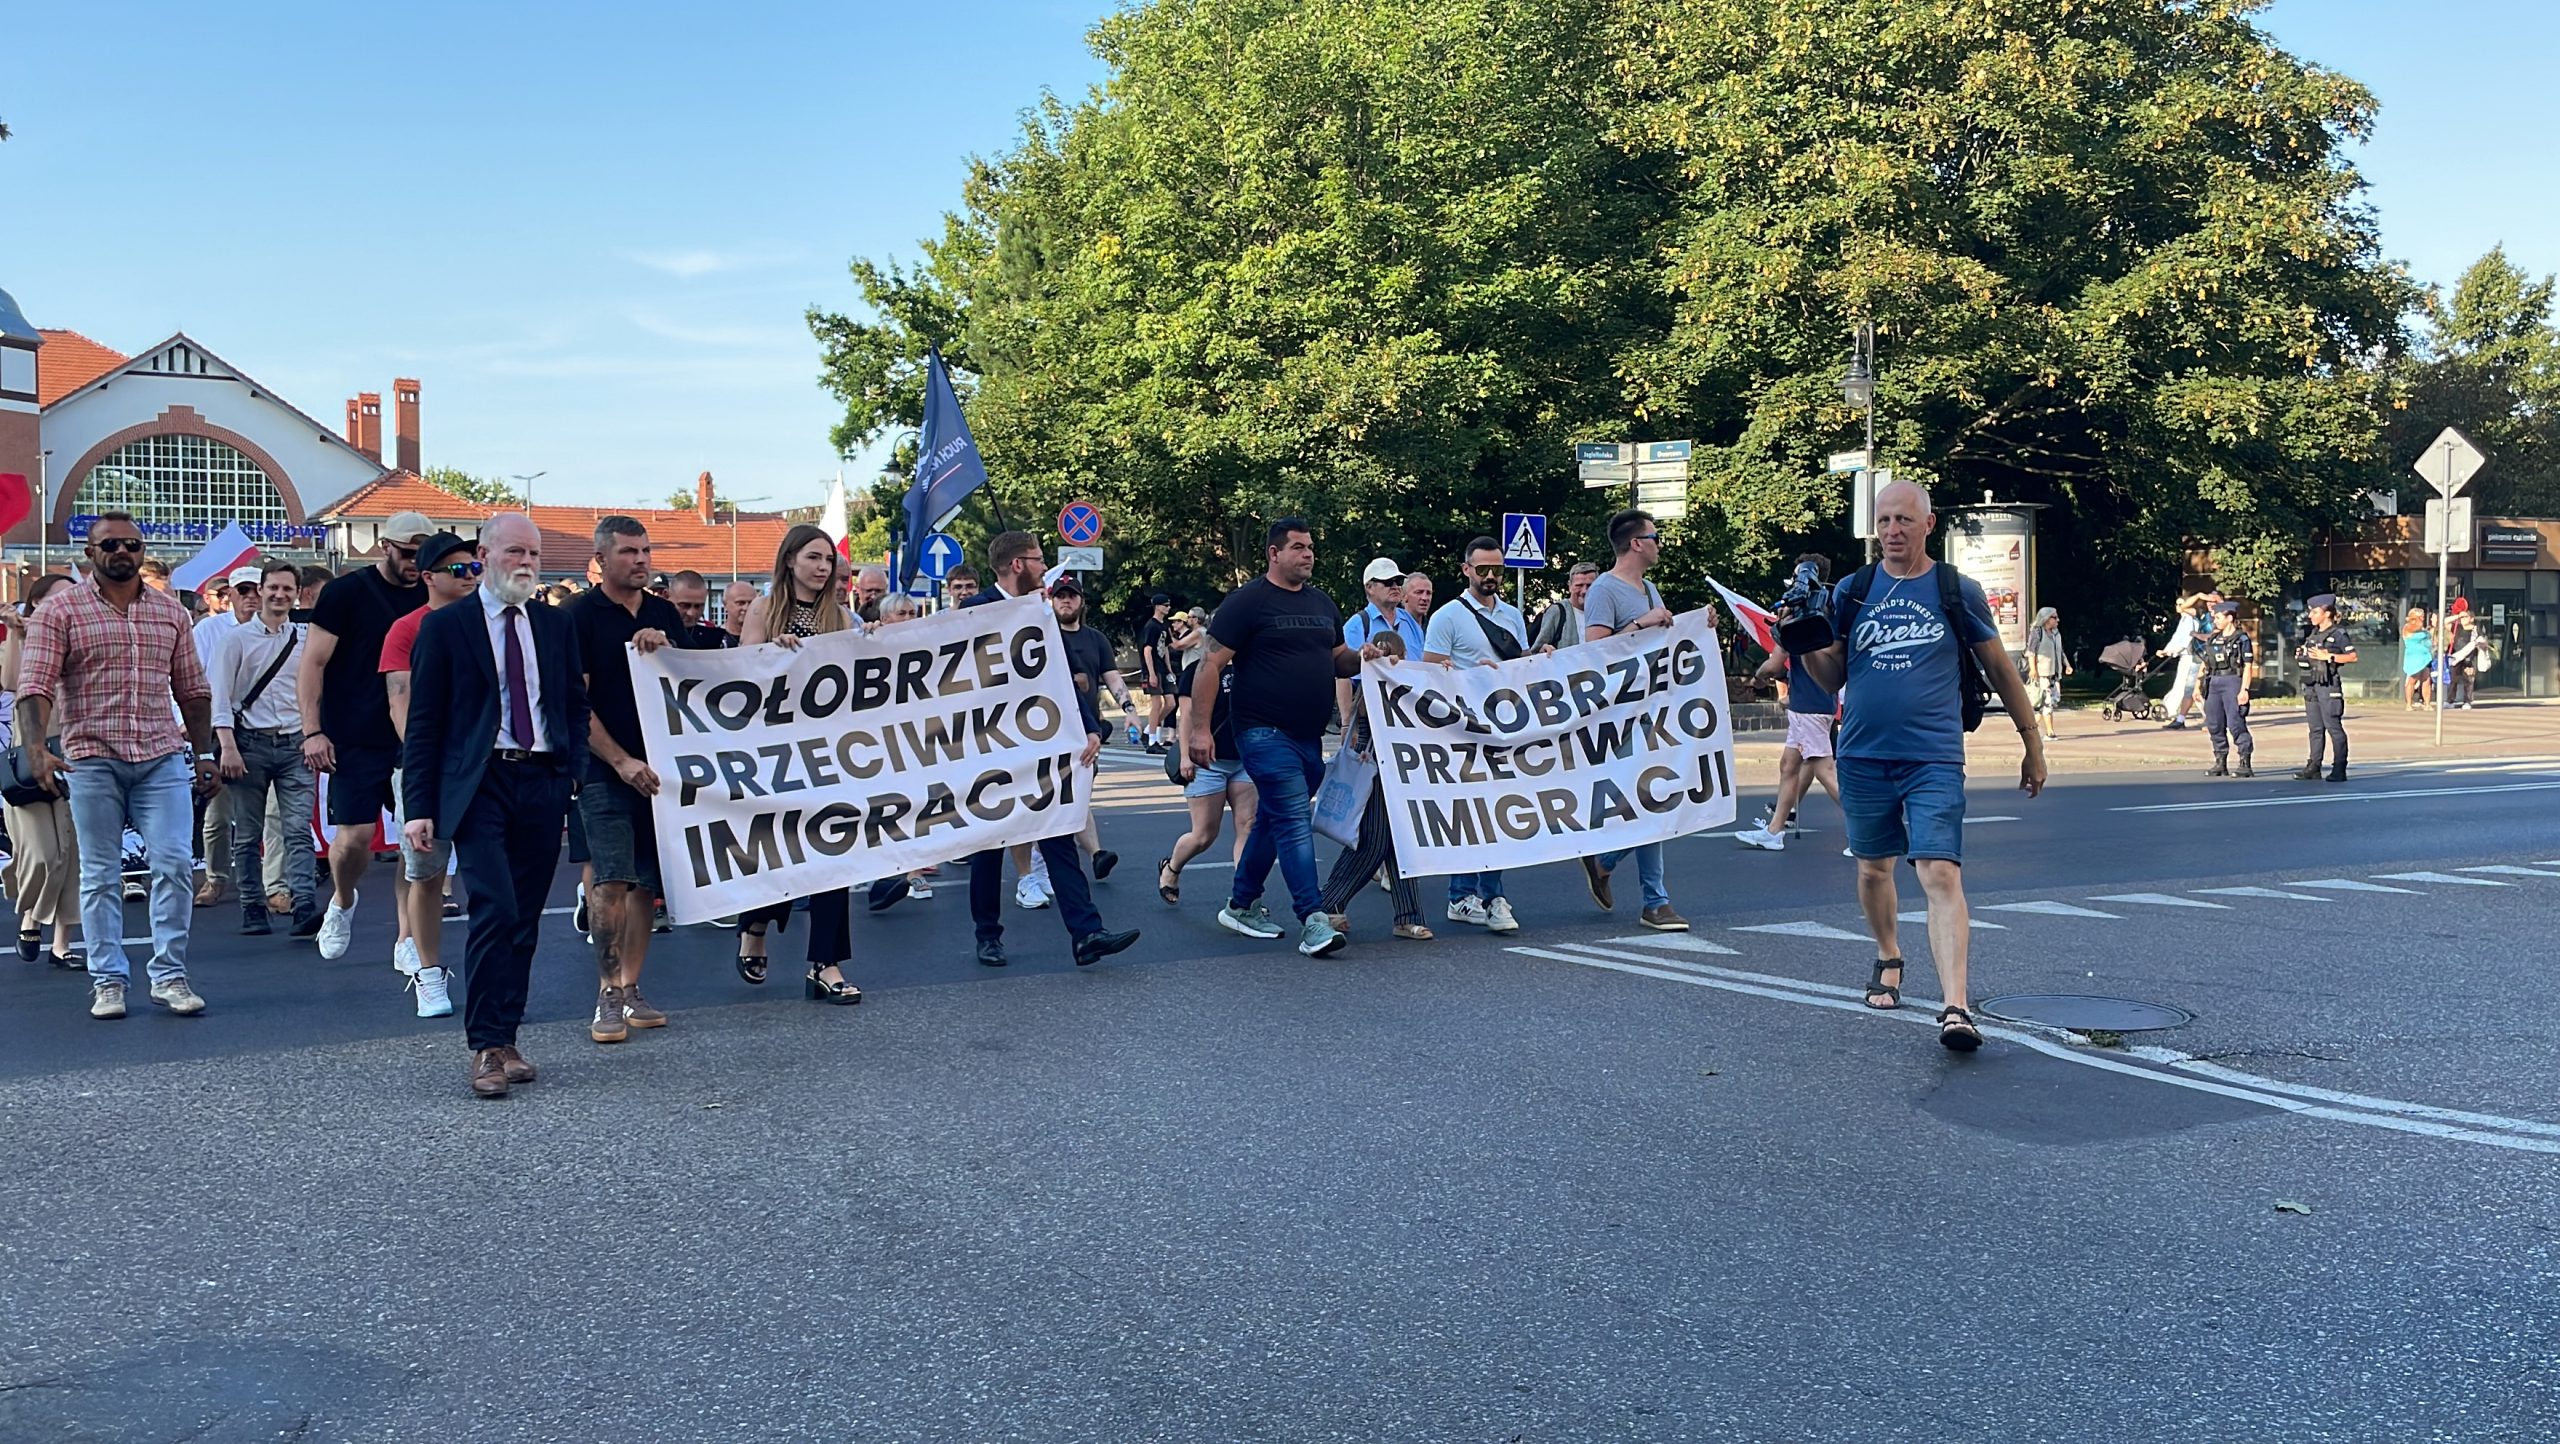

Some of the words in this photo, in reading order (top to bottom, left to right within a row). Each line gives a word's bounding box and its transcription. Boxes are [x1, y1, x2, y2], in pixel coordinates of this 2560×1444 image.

[138, 521, 221, 540] worzec
[1856, 620, 1945, 652] Diverse
[1867, 599, 1905, 618] WORLD'S
[1906, 600, 1935, 621] FINEST
[659, 626, 1047, 735] KOŁOBRZEG
[1378, 639, 1705, 734] KOŁOBRZEG
[675, 695, 1061, 807] PRZECIWKO
[1392, 698, 1717, 784] PRZECIWKO
[685, 753, 1074, 888] IMIGRACJI
[1407, 750, 1731, 847] IMIGRACJI
